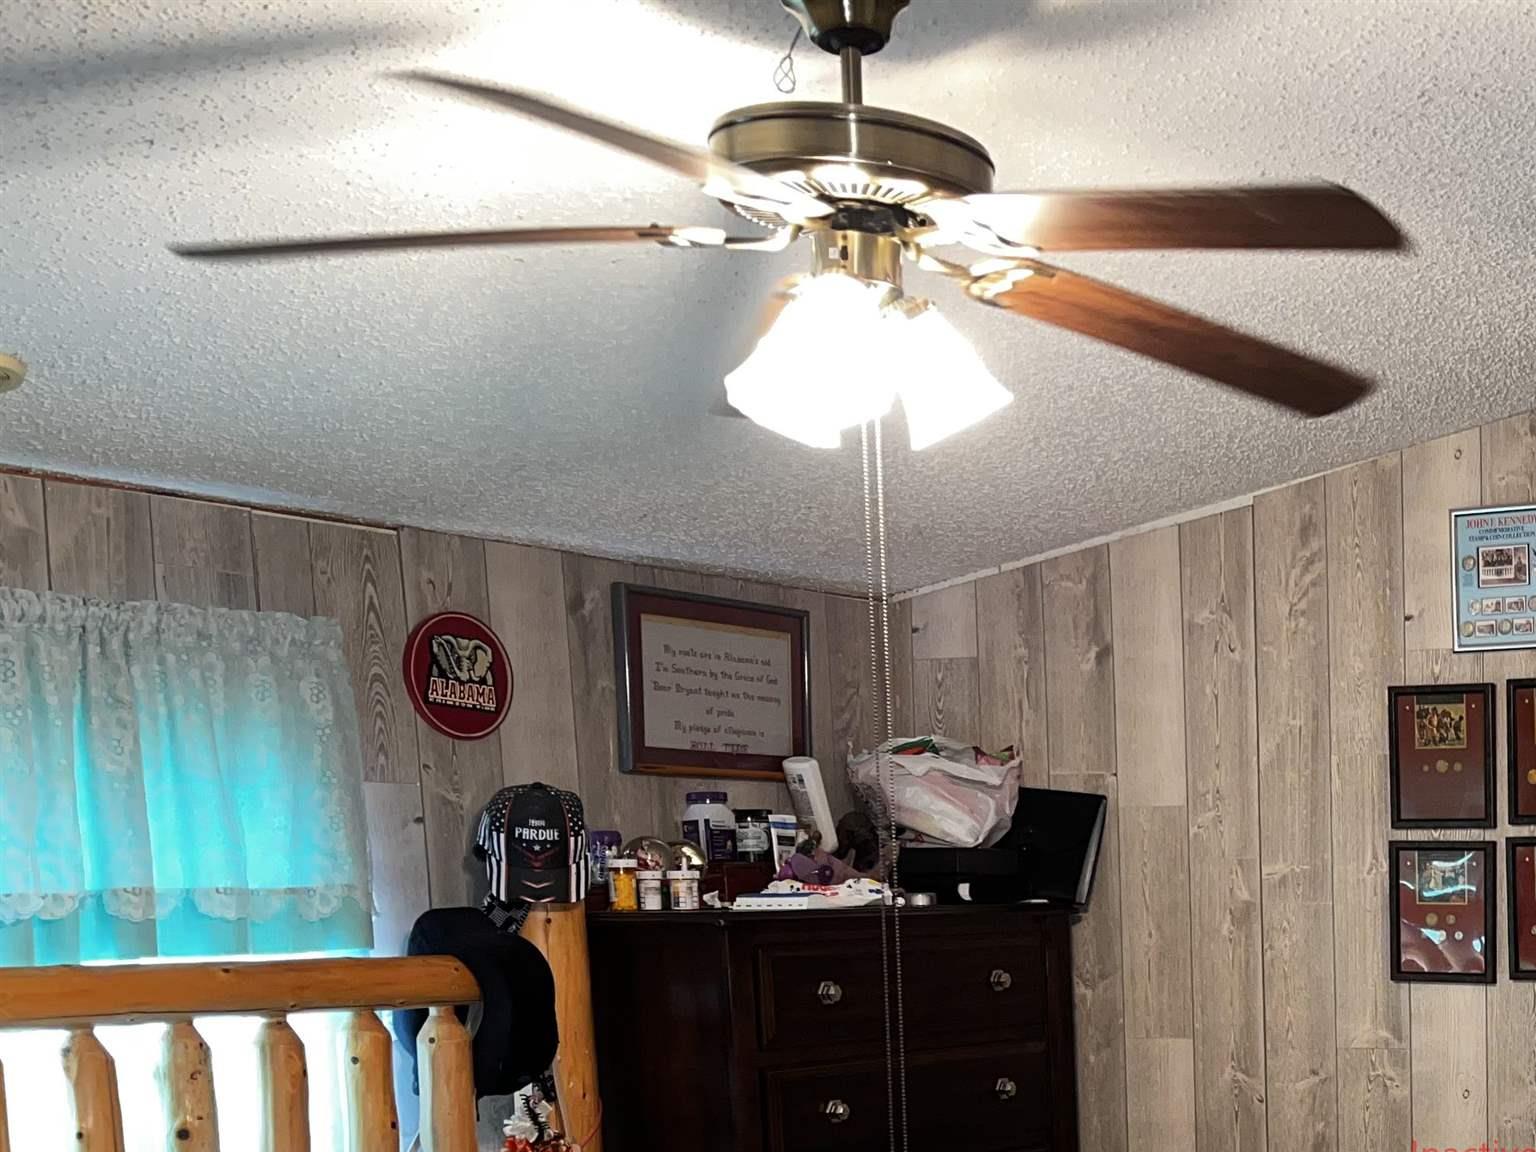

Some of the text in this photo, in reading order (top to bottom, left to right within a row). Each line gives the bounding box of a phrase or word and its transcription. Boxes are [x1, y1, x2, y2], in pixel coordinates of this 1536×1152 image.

[1466, 519, 1489, 528] JOHN
[1498, 514, 1536, 526] KENNEDY
[671, 663, 707, 677] Southern
[709, 669, 718, 681] by
[720, 671, 733, 680] the
[428, 676, 497, 707] ALABAMA
[514, 826, 560, 841] PARDUE
